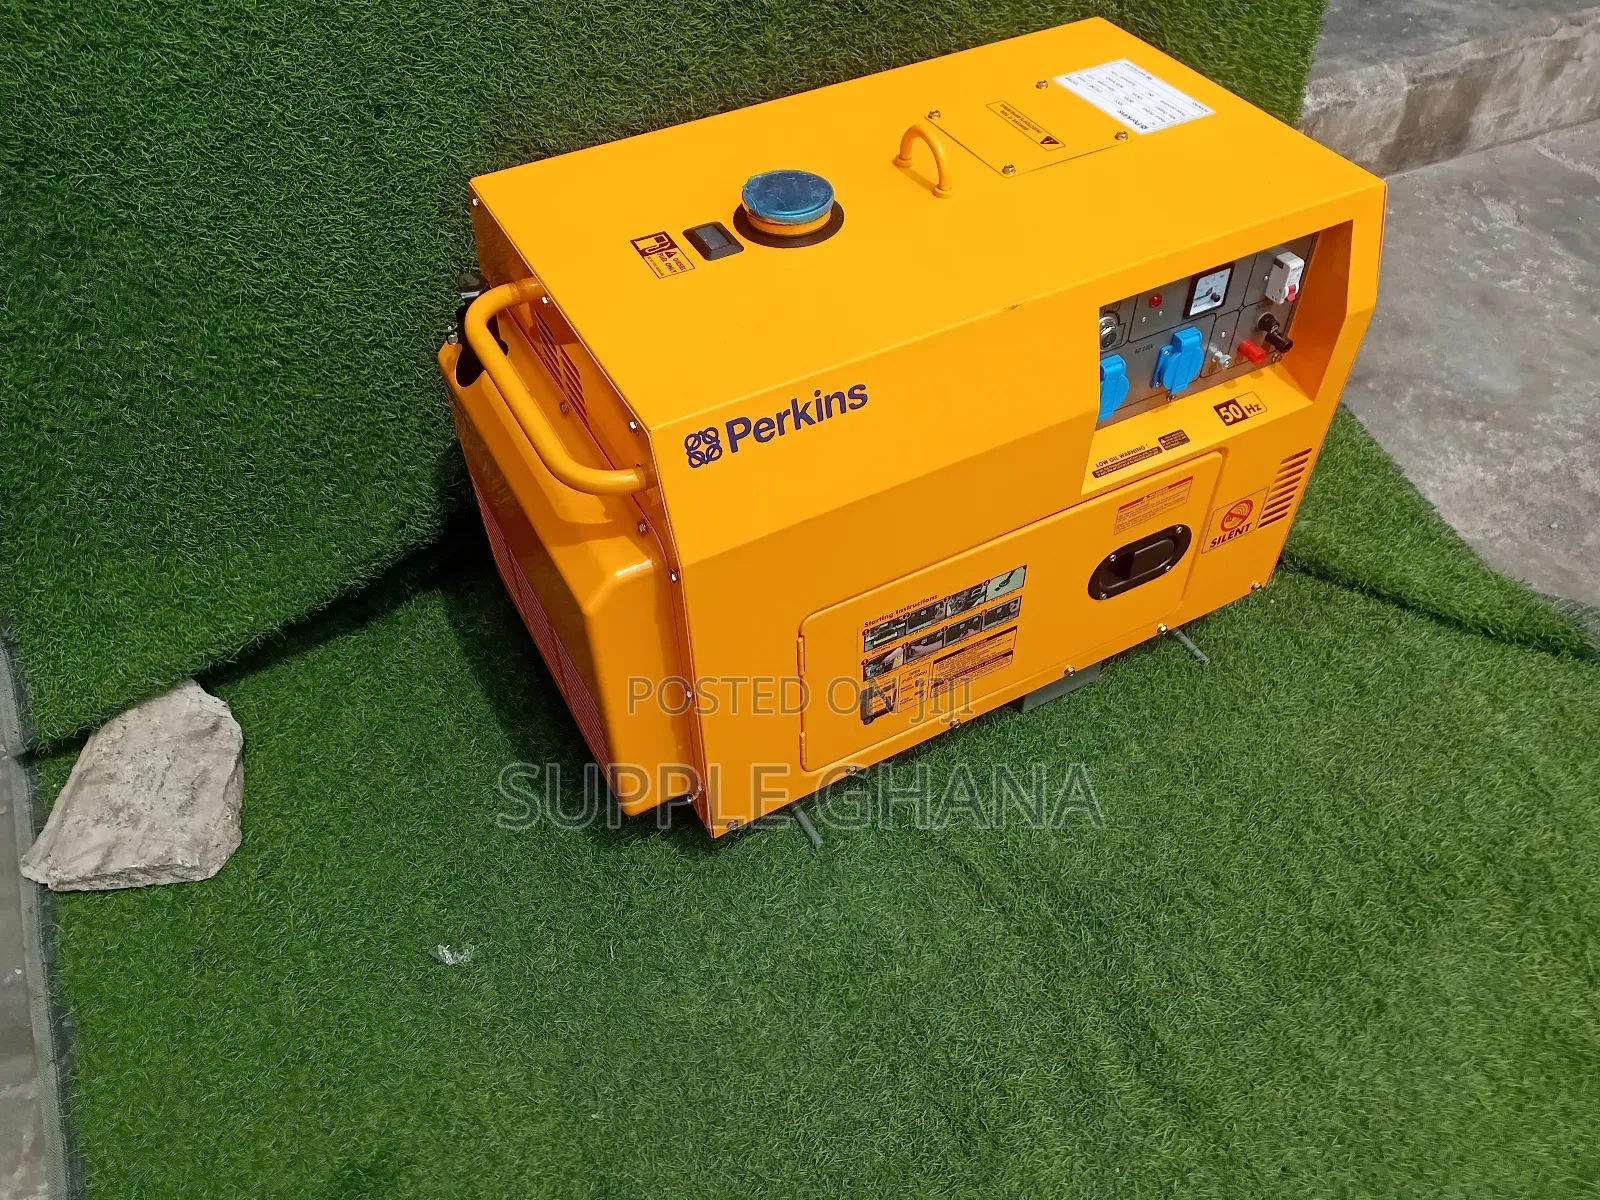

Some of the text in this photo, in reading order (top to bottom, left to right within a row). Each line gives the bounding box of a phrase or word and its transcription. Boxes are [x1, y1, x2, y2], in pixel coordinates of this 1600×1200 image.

[658, 252, 678, 274] FUEL ONLY
[725, 383, 869, 454] Perkins
[1218, 402, 1262, 424] 50 Hz
[1095, 458, 1109, 468] LOW
[1109, 454, 1119, 464] OIL
[1119, 444, 1146, 461] WARNING
[1209, 522, 1253, 549] SILENT
[864, 612, 894, 628] Starting
[895, 594, 939, 615] Instructions
